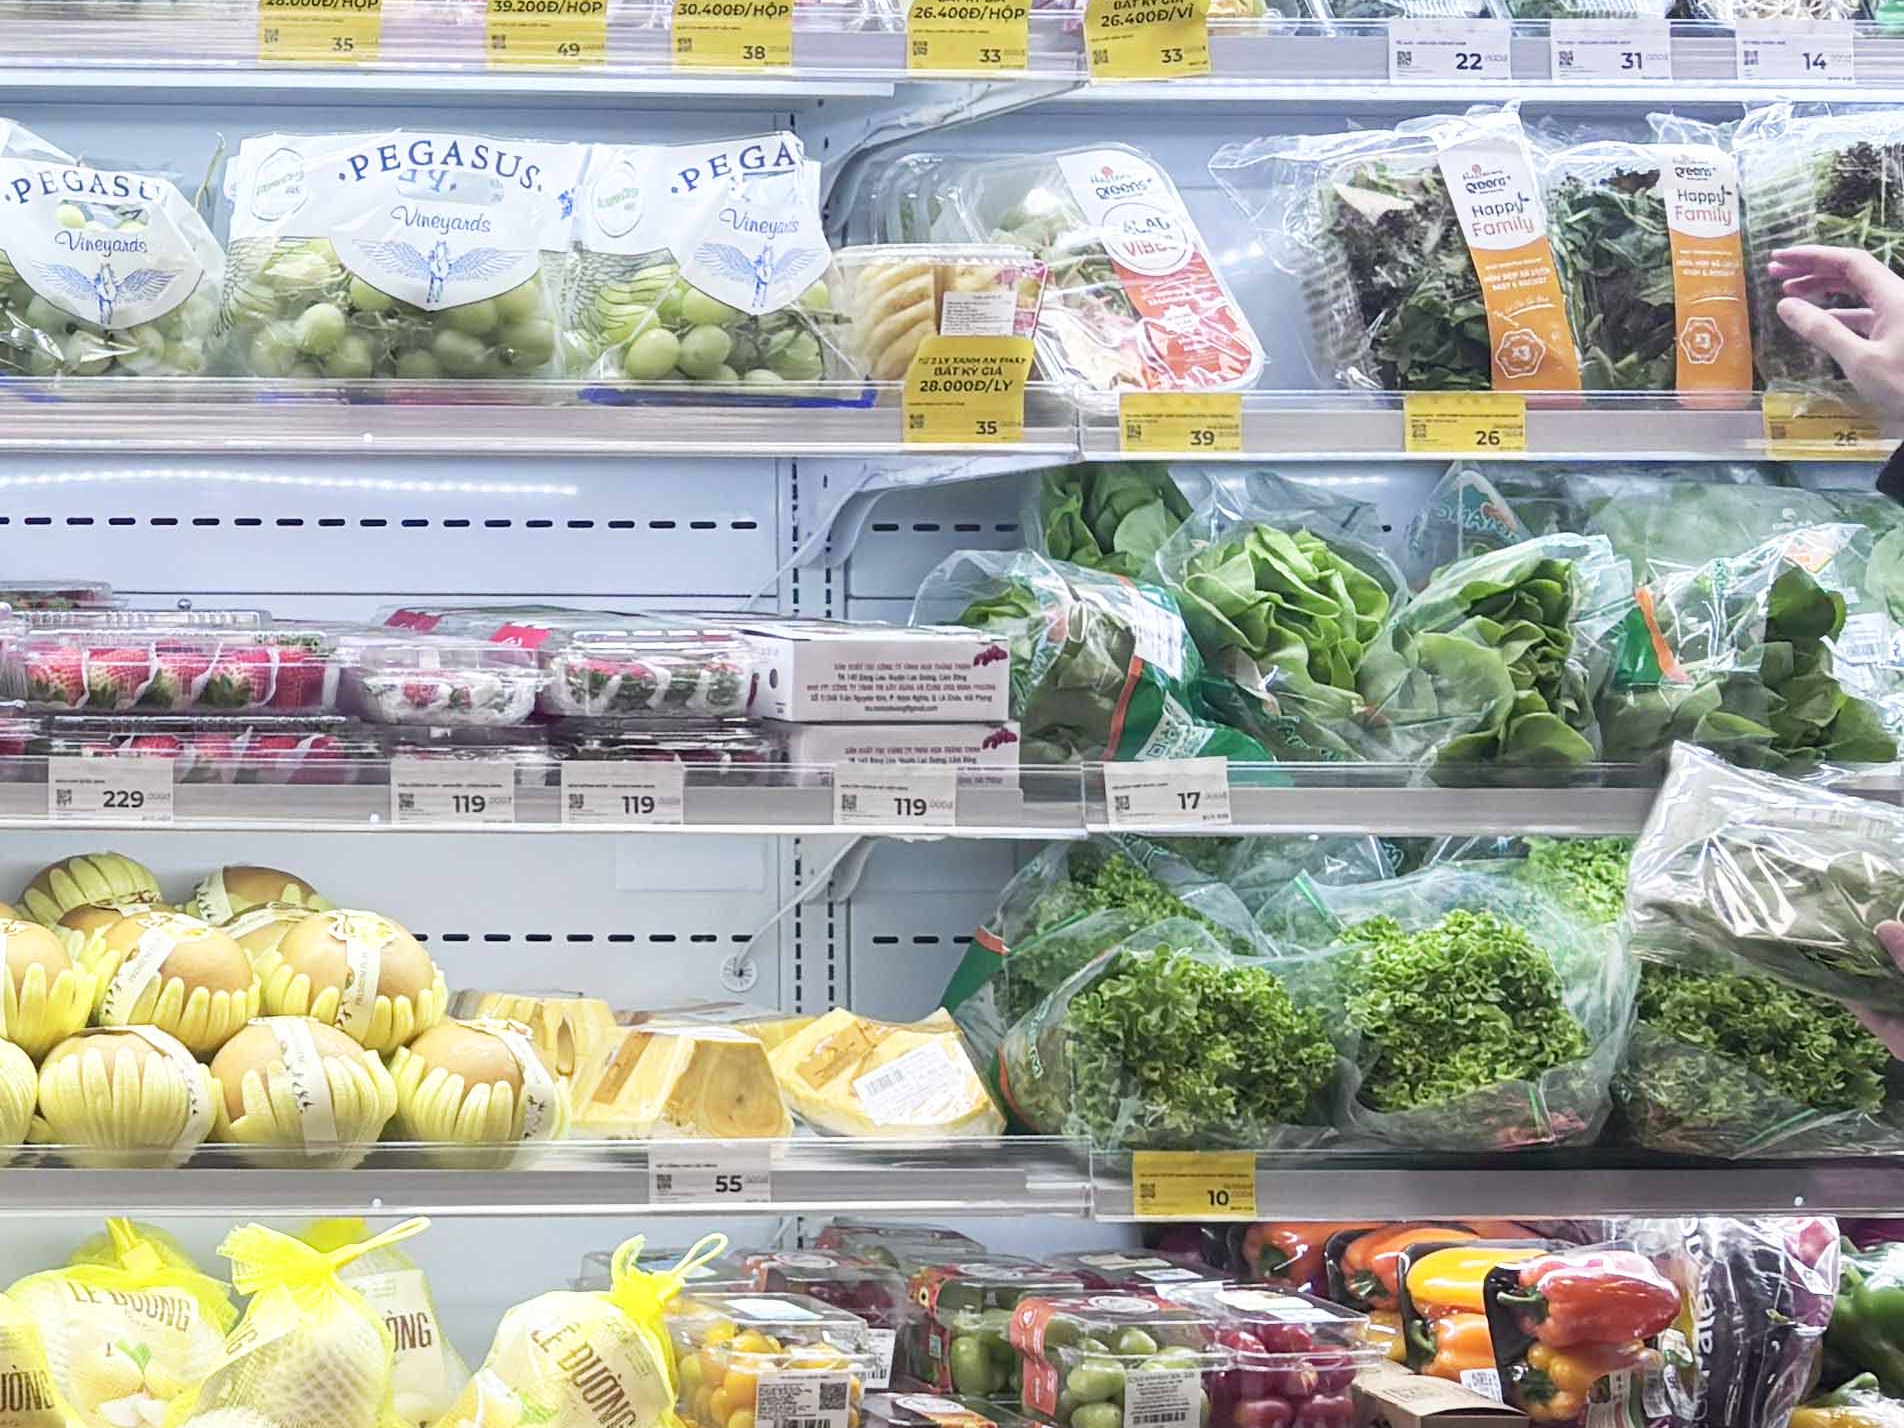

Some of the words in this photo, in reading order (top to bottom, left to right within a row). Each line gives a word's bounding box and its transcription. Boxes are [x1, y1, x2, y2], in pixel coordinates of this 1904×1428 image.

[1455, 53, 1483, 70] 22
[1621, 52, 1642, 70] 31
[1802, 52, 1826, 70] 14
[391, 205, 491, 233] Vineyards
[1472, 214, 1535, 236] Family
[1675, 206, 1732, 228] Family
[56, 230, 148, 255] Vineyards
[976, 420, 997, 435] 35
[1190, 431, 1214, 446] 39
[1476, 430, 1500, 445] 26
[103, 790, 144, 808] 229
[452, 795, 485, 812] 119
[622, 795, 655, 814] 119
[894, 798, 927, 816] 119
[1177, 791, 1201, 810] 17
[715, 1175, 743, 1193] 55
[1208, 1189, 1229, 1206] 10
